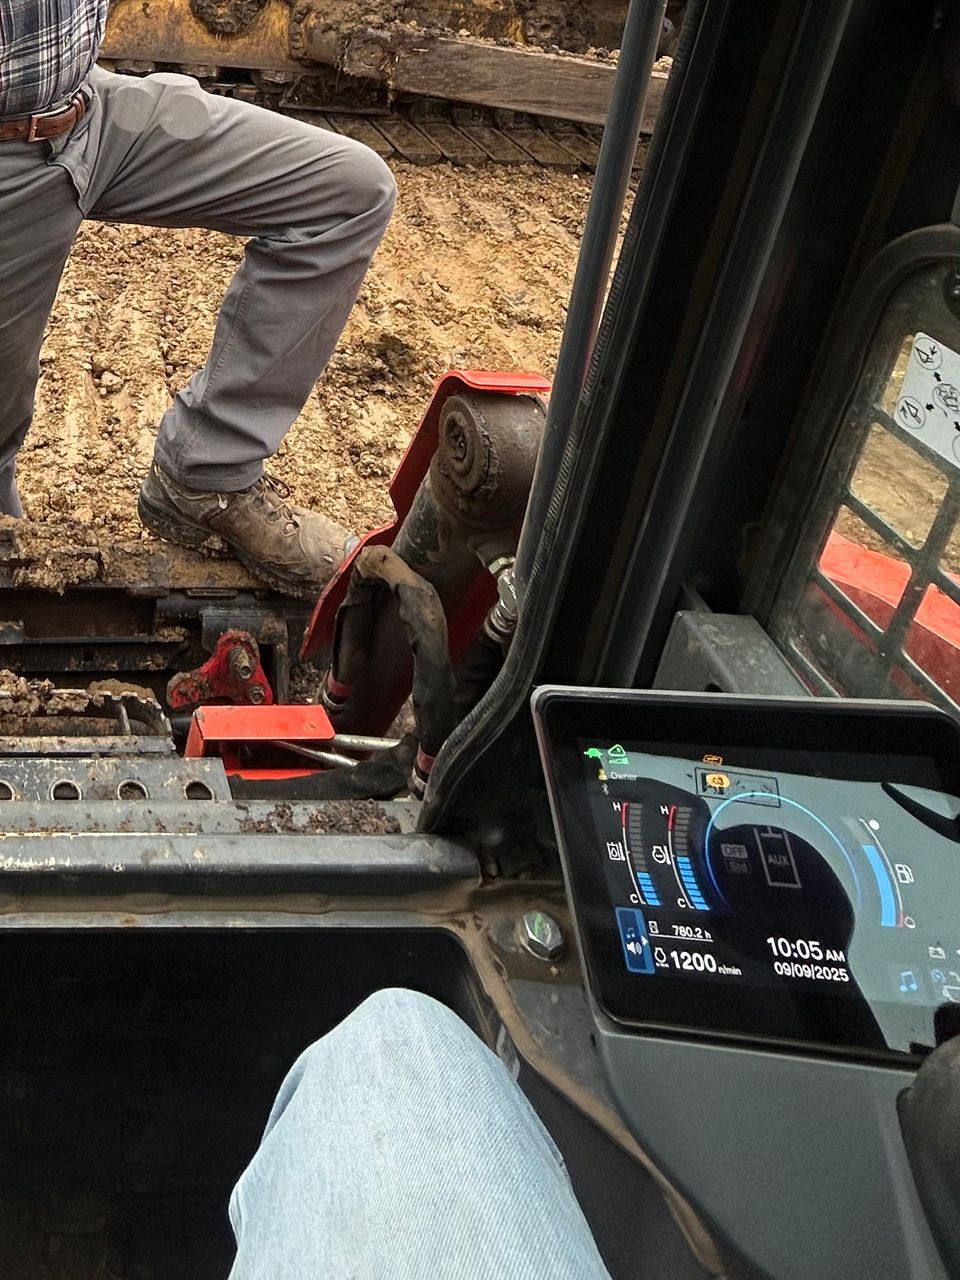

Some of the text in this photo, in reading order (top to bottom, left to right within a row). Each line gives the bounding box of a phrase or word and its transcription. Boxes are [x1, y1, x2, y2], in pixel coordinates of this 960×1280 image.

[612, 801, 621, 811] H
[660, 805, 669, 815] H
[724, 846, 746, 857] OFF
[768, 854, 790, 866] AUX
[630, 893, 639, 903] C
[677, 897, 686, 907] C
[671, 924, 711, 939] 780.2 h
[766, 936, 845, 962] 10:05 AM
[670, 950, 717, 973] 1200
[774, 961, 849, 983] 09/09/2025
